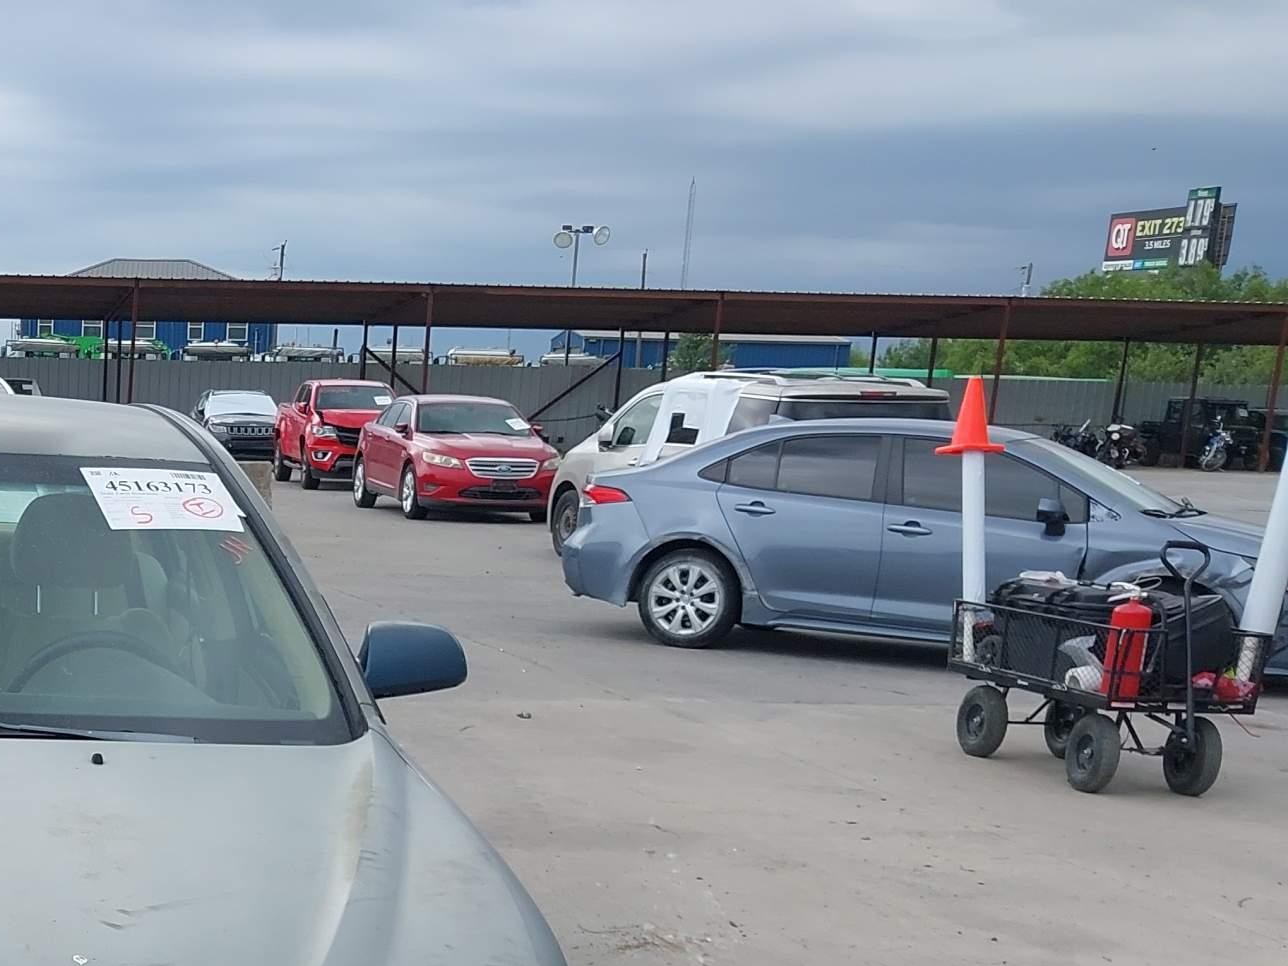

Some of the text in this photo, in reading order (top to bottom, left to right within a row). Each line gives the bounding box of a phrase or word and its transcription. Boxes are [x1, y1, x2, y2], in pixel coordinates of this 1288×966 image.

[1136, 217, 1185, 236] EXIT 273
[1112, 223, 1131, 250] QT
[105, 480, 212, 495] 45163173
